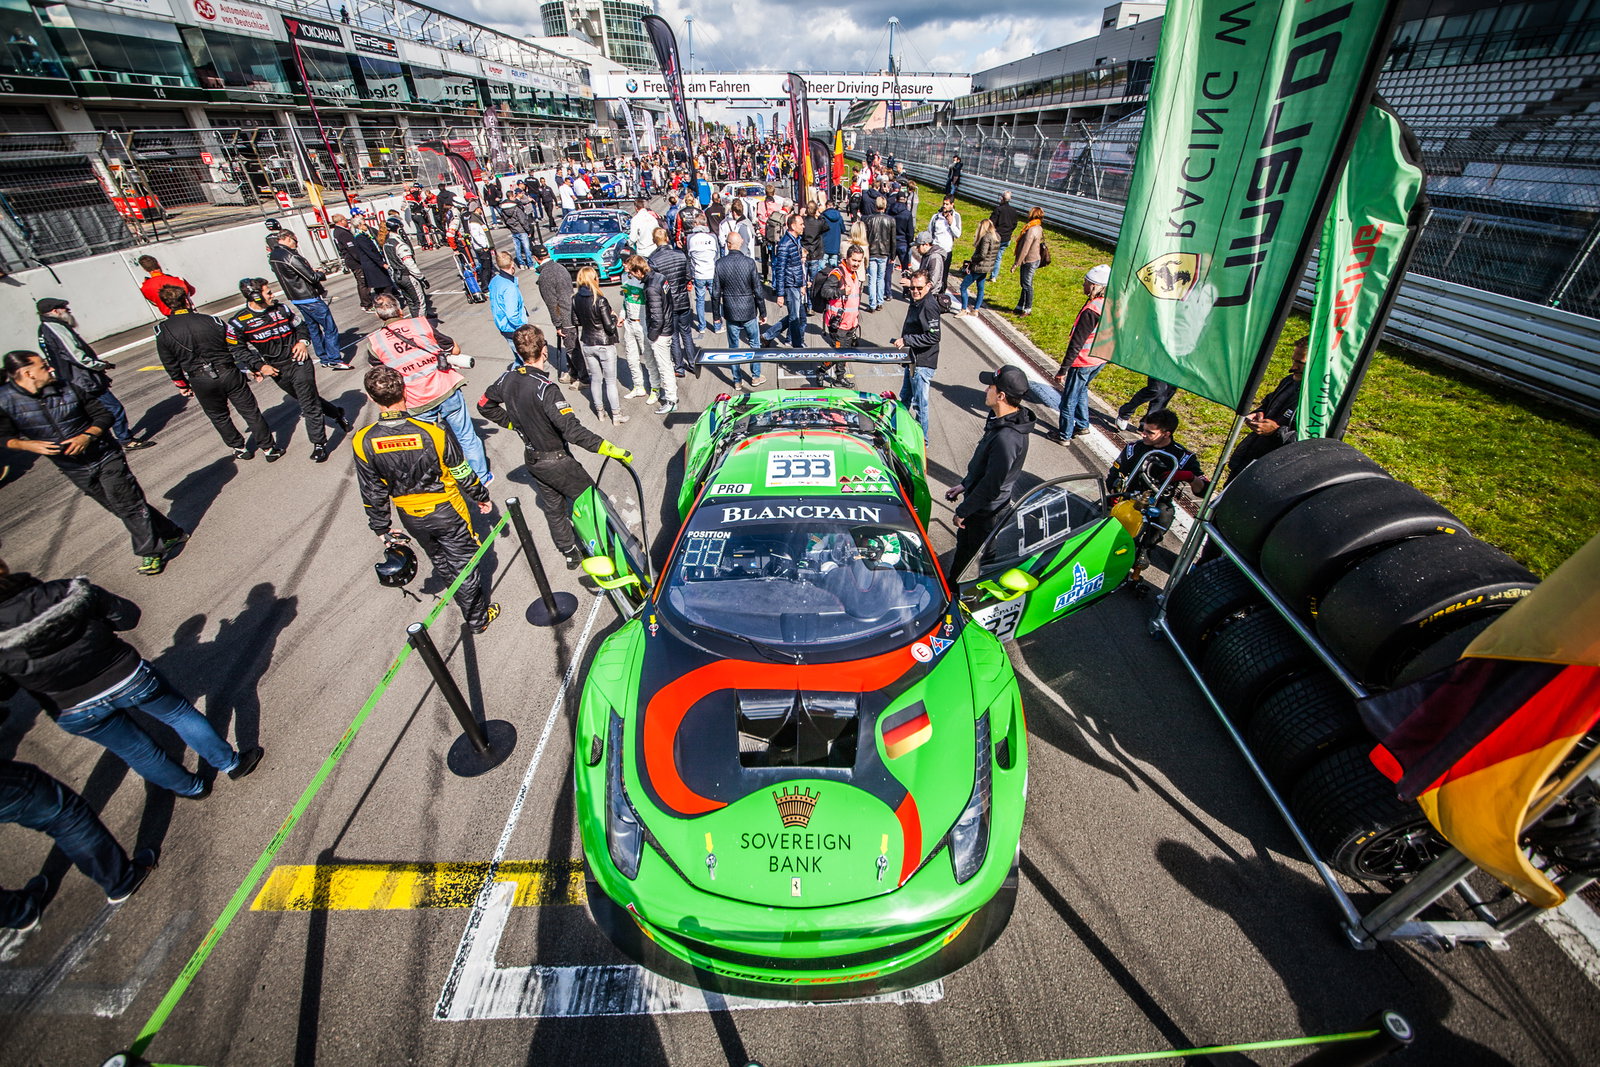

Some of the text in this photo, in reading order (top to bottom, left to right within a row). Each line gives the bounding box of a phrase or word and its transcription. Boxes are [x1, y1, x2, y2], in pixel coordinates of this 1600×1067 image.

[220, 4, 264, 21] Automobilclub
[221, 15, 270, 31] von Deutschland
[299, 23, 342, 43] YOKOHAMA
[153, 88, 167, 100] 14
[643, 80, 750, 93] Freu am Fahren
[837, 81, 879, 96] Driving
[882, 81, 933, 95] Pleasure
[259, 94, 269, 104] 13
[253, 325, 291, 340] NISSAN
[402, 364, 415, 374] PIT
[376, 437, 417, 450] PIRELLI
[771, 458, 831, 479] 333
[716, 483, 745, 494] PRO
[721, 504, 881, 524] BLANCPAIN
[687, 530, 731, 539] POSITION
[1418, 594, 1484, 629] PIRELLI
[740, 833, 852, 851] SOVEREIGN
[768, 856, 822, 874] BANK
